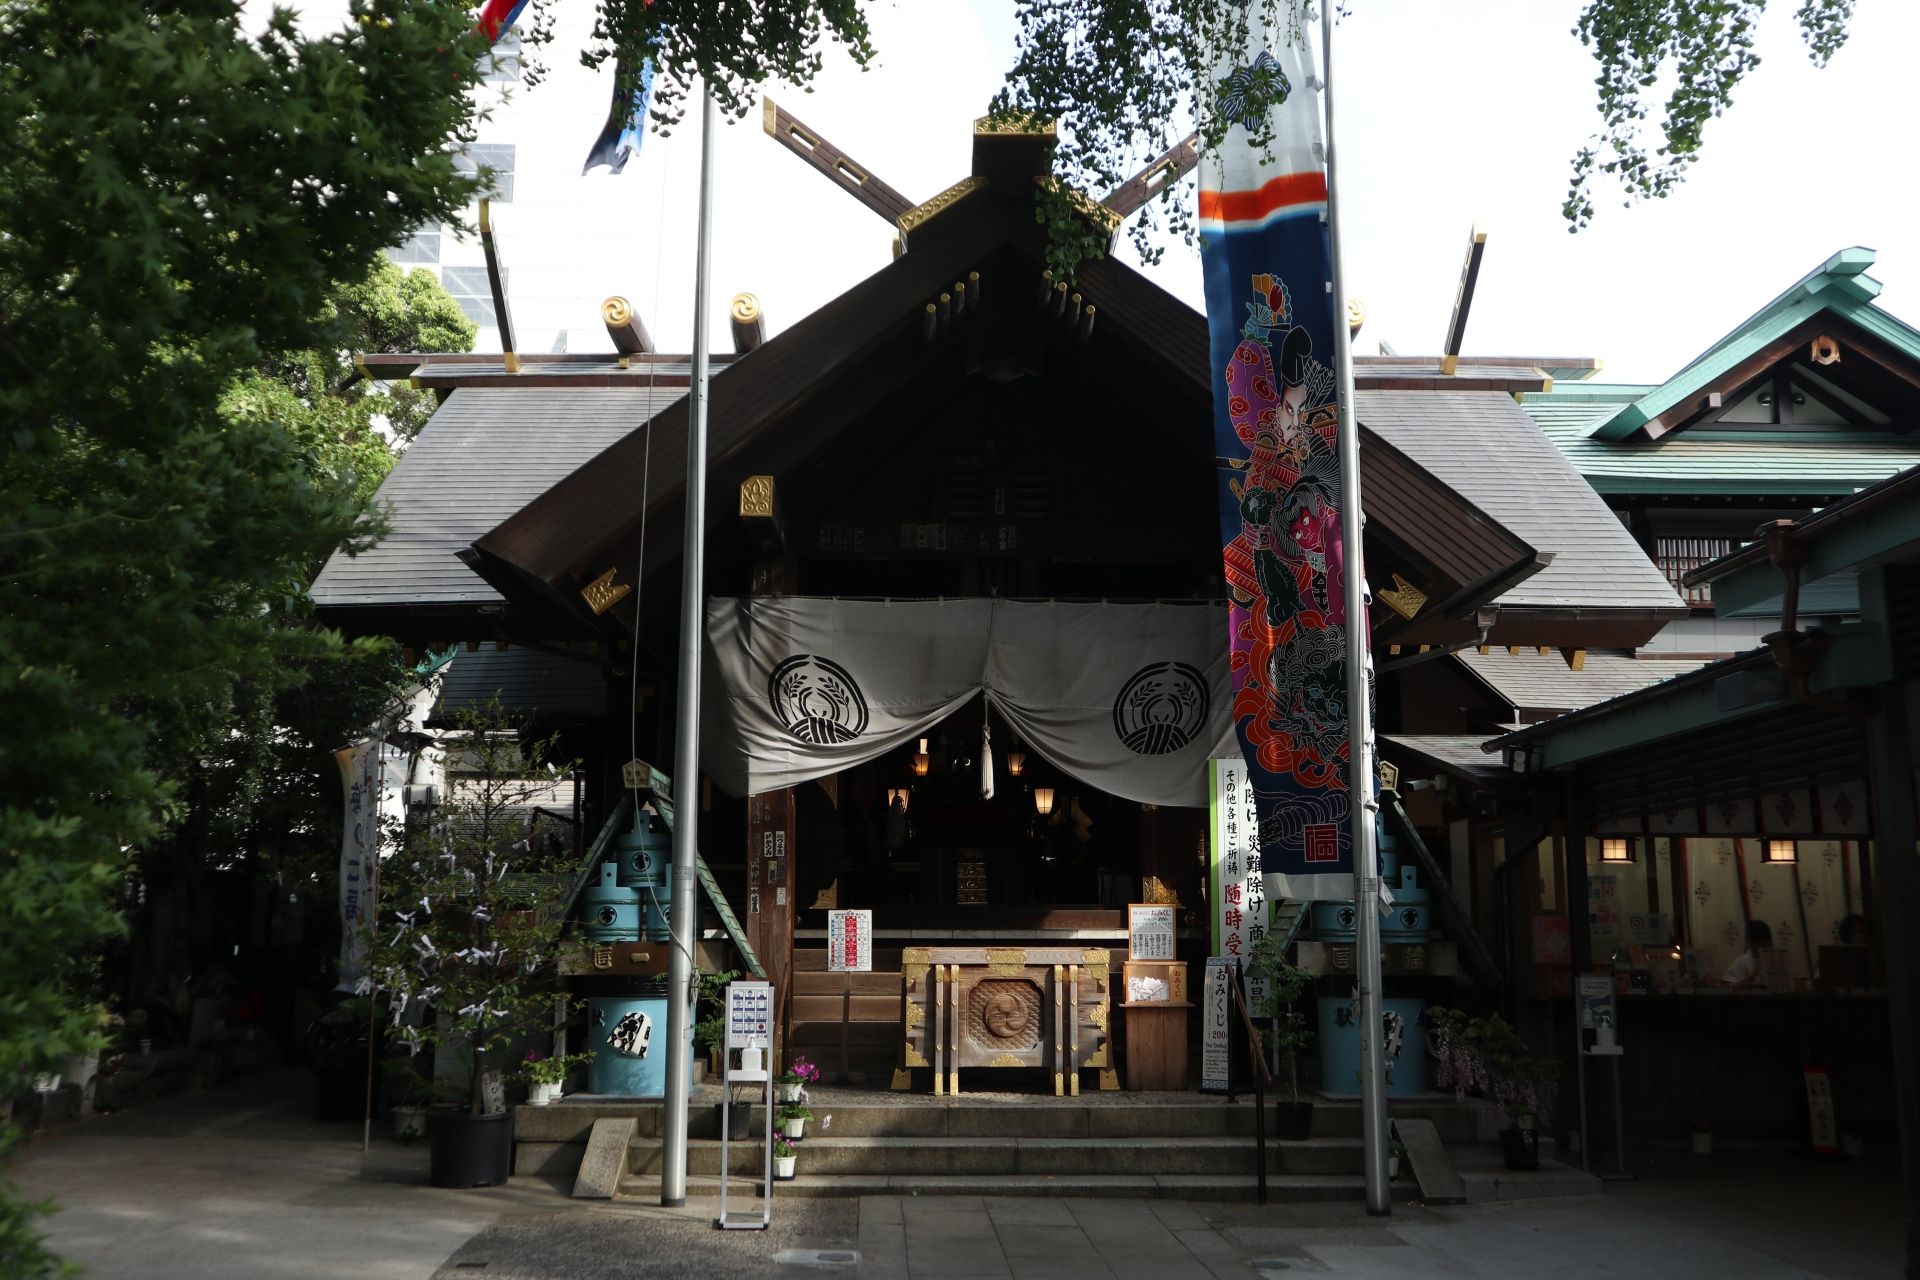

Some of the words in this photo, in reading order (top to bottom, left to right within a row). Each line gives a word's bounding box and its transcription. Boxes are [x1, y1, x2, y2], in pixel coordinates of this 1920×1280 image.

[1226, 770, 1239, 875] その他各種ご祈祷
[1224, 884, 1243, 956] 随時受
[1244, 770, 1265, 1002] 除け・災難除け・商昌
[1215, 968, 1226, 1027] おみくじ
[1212, 1030, 1227, 1039] 200
